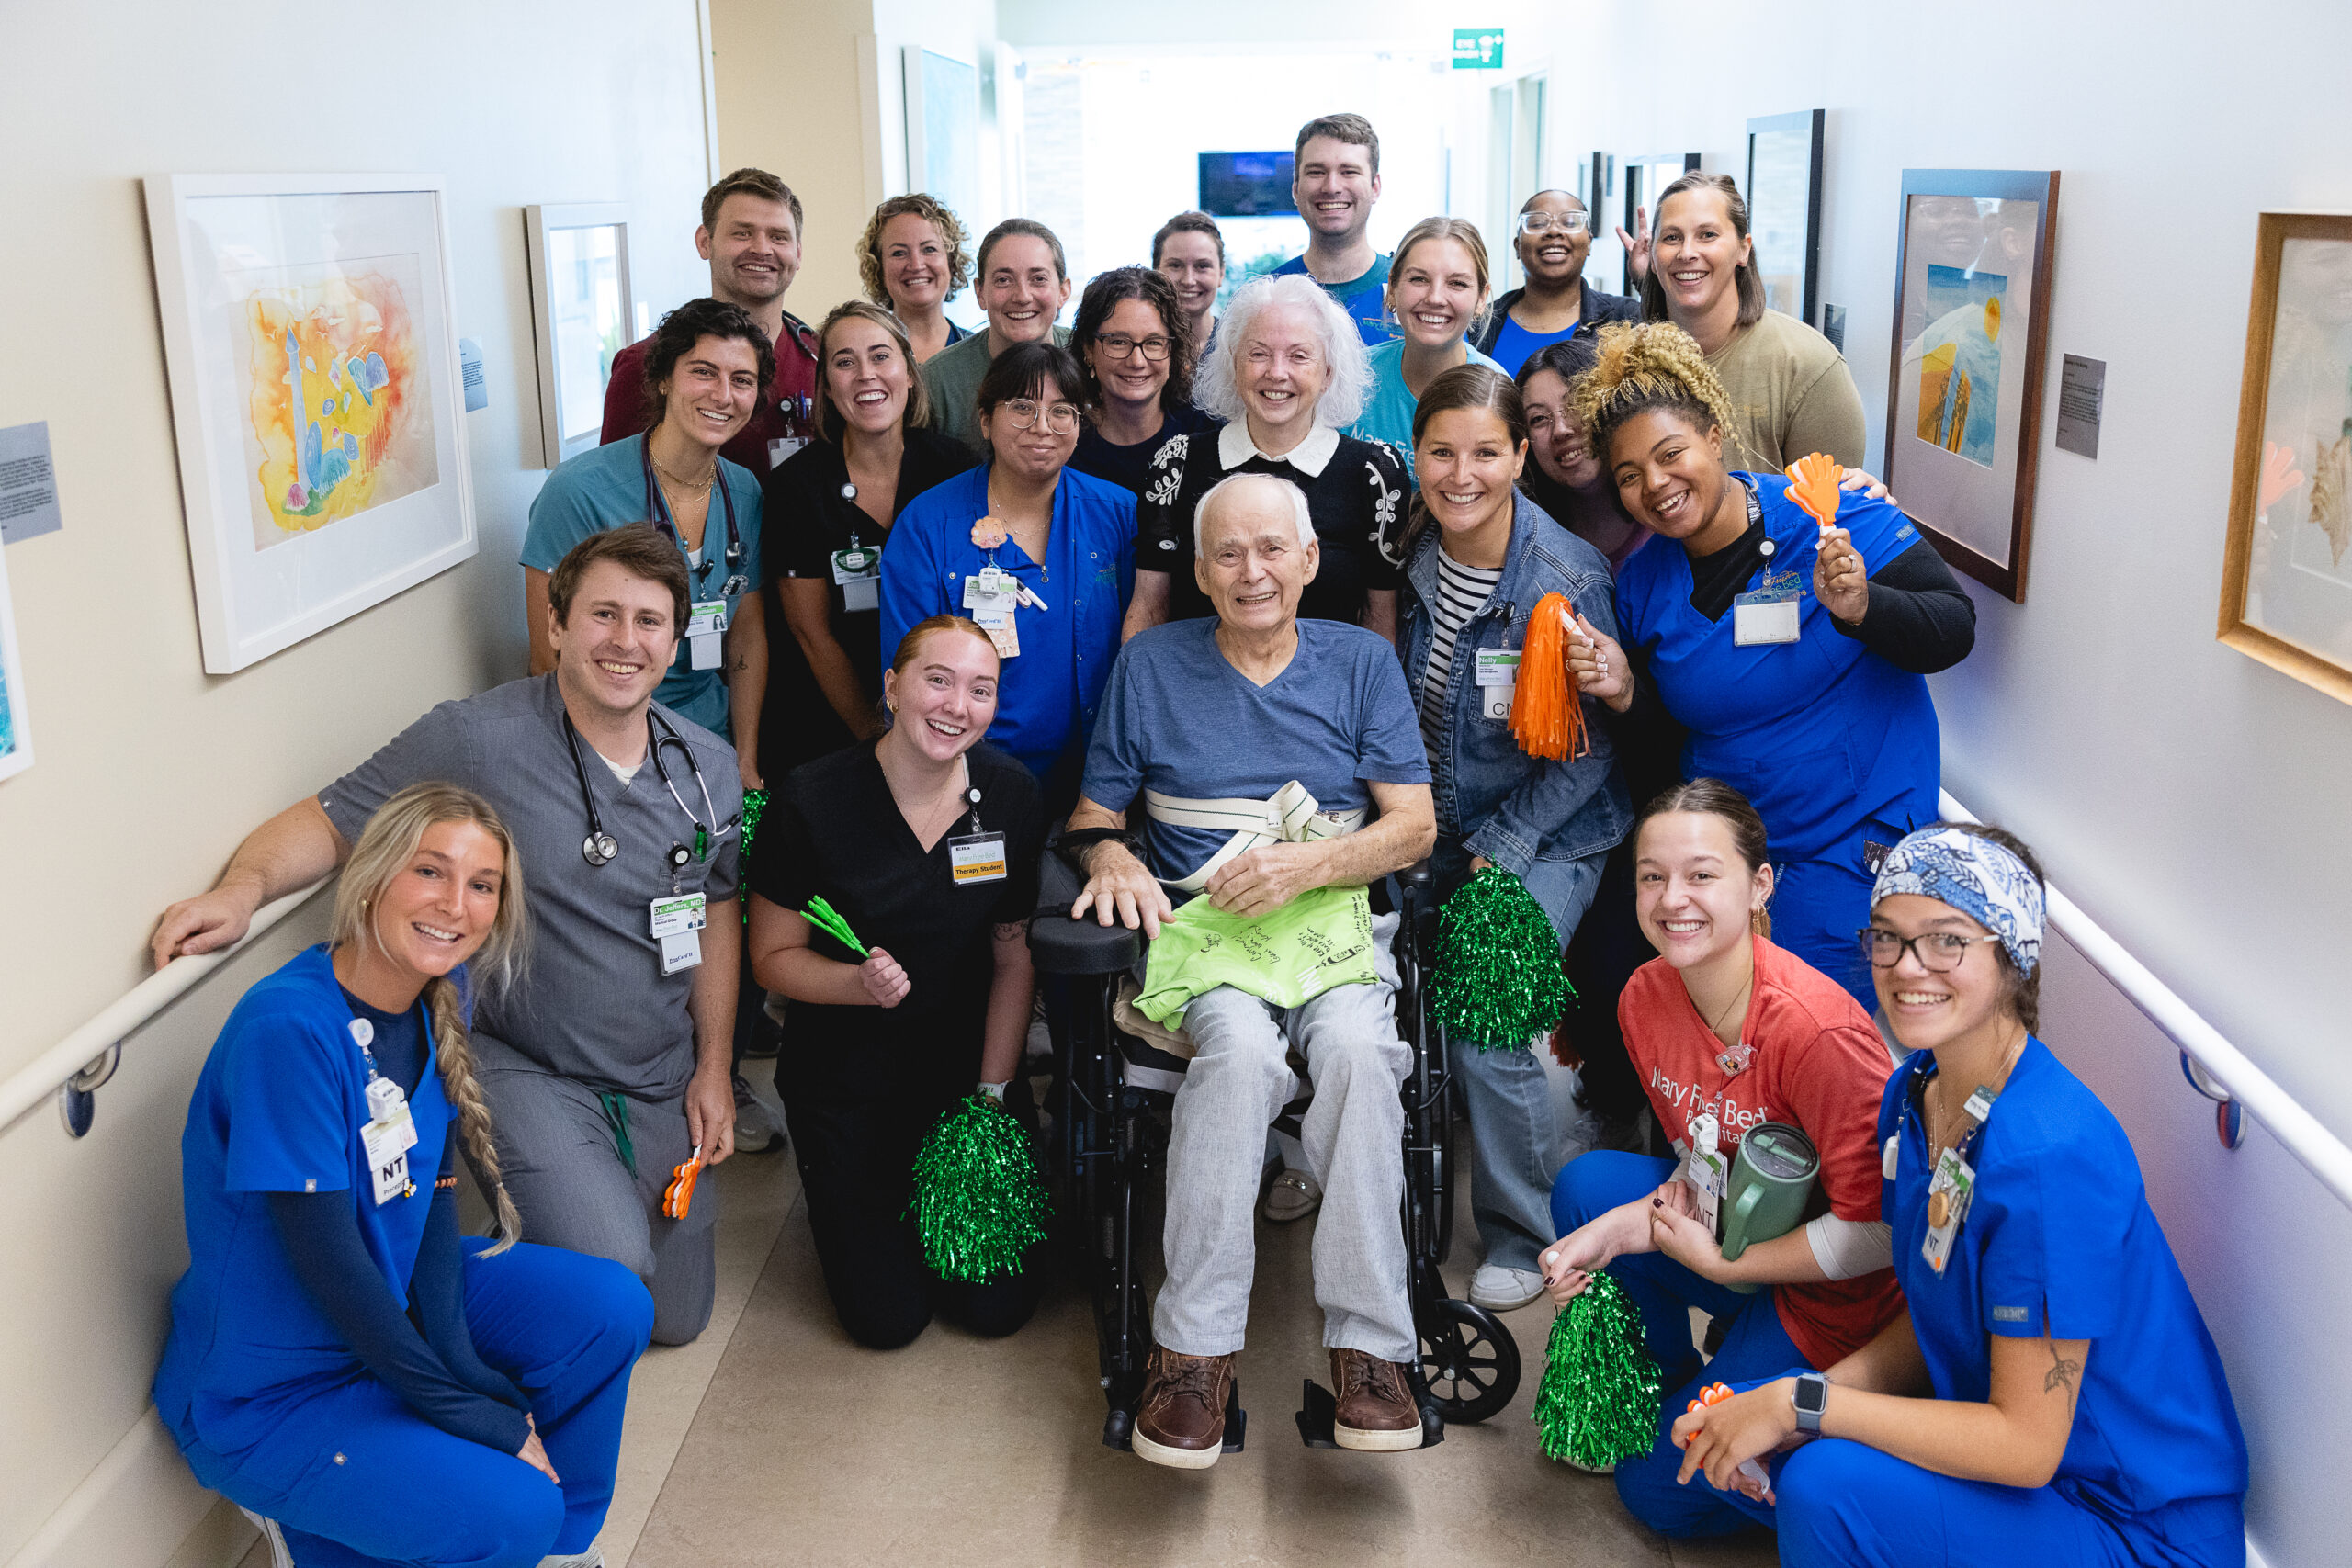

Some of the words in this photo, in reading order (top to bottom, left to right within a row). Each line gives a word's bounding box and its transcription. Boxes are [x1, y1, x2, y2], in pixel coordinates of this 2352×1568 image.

[1782, 574, 1802, 590] Bed
[956, 866, 979, 875] Therapy
[980, 863, 1003, 873] Student
[664, 903, 689, 912] Jeffers,
[1724, 1099, 1767, 1130] Bed
[382, 1156, 404, 1183] NT
[1696, 1203, 1713, 1230] NT
[1927, 1233, 1939, 1253] NT
